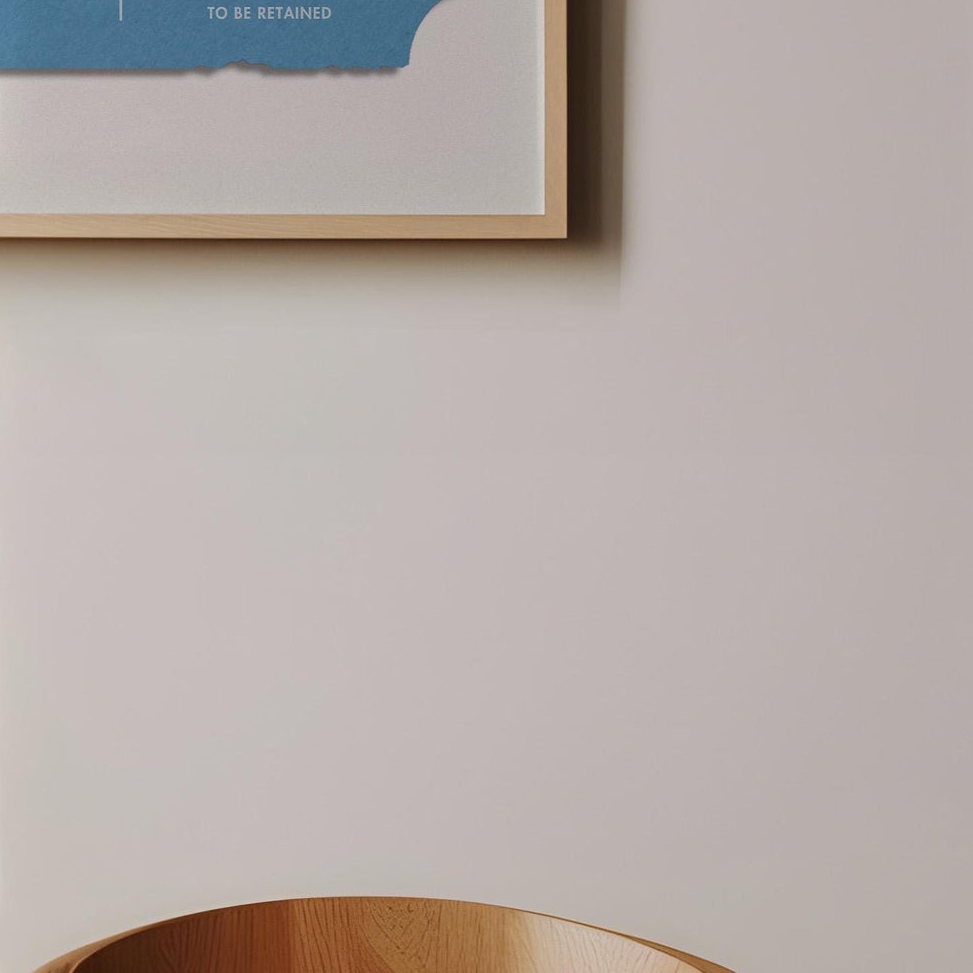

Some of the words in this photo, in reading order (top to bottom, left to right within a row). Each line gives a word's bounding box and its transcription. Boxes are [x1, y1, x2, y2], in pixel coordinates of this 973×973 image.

[207, 7, 227, 19] TO
[235, 7, 250, 19] BE
[258, 7, 331, 19] RETAINED
